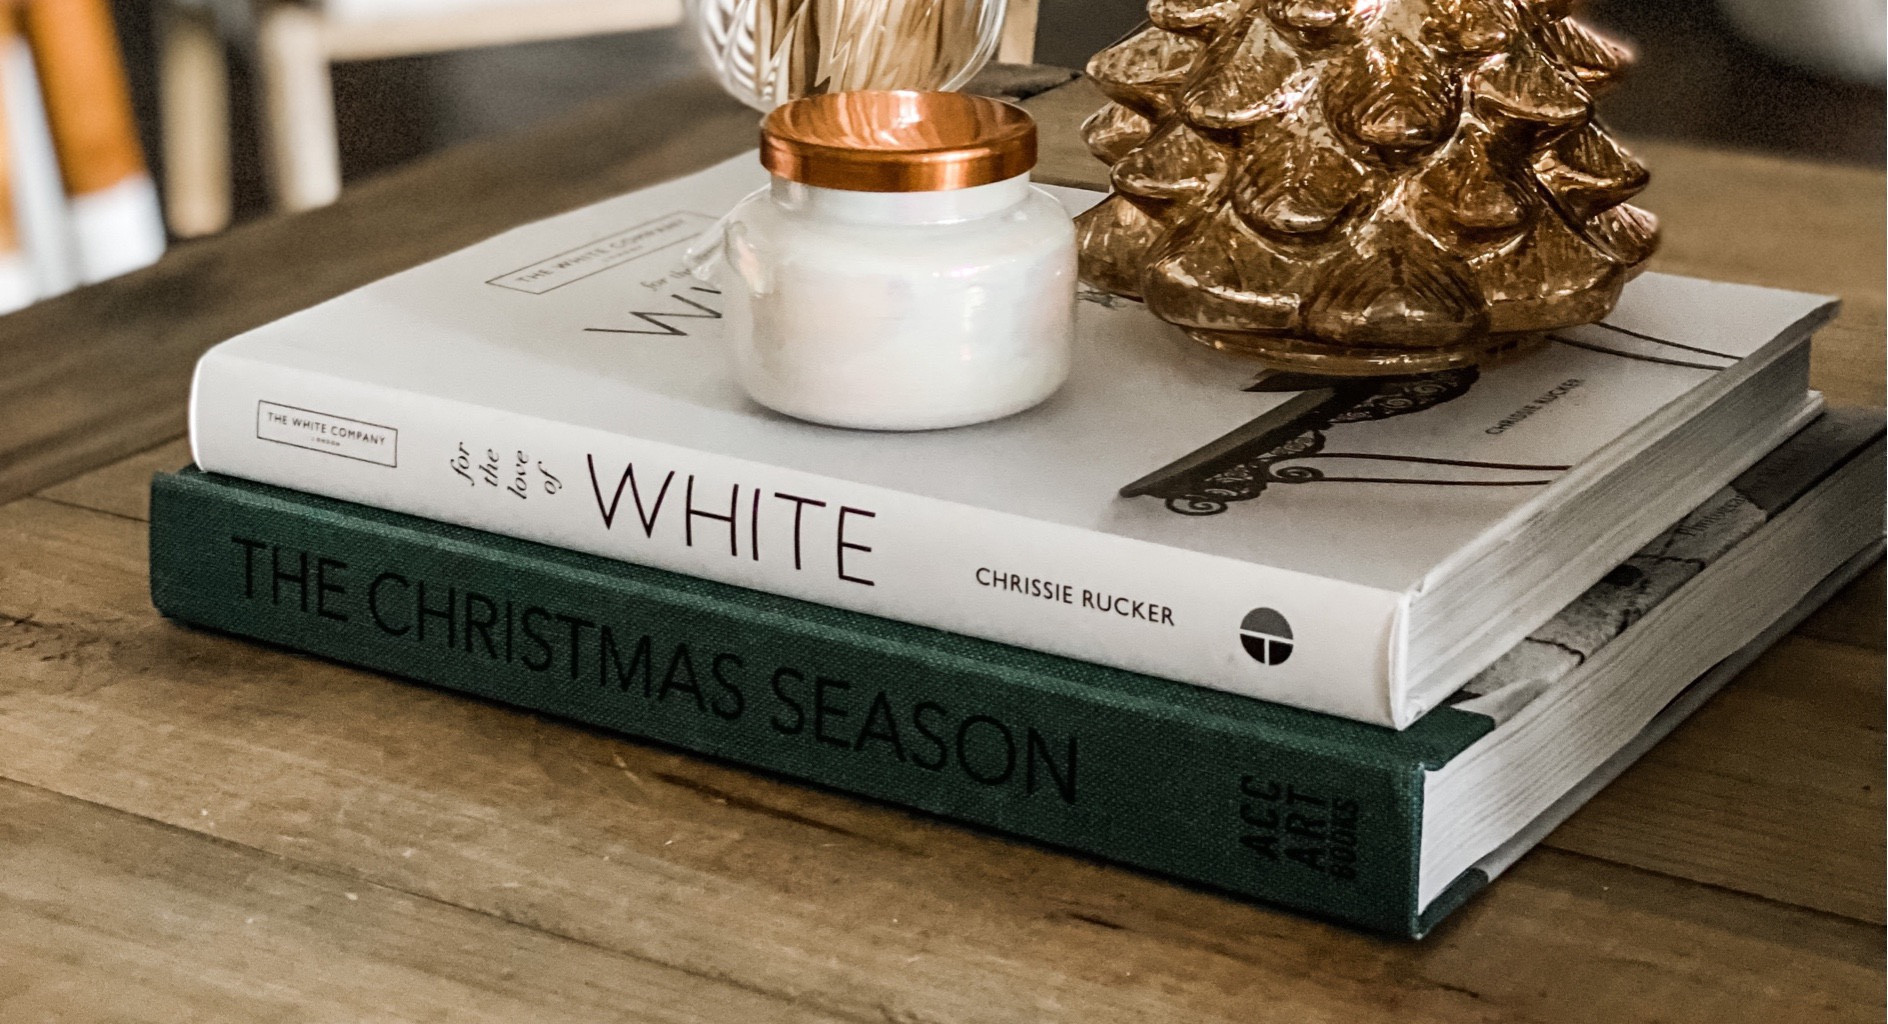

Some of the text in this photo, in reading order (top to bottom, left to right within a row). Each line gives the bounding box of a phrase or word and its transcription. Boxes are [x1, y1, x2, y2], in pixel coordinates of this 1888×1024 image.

[268, 412, 386, 446] THE WHITE COMPANY
[450, 441, 475, 487] for
[478, 448, 500, 487] the
[507, 450, 529, 499] love
[537, 460, 562, 495] of
[587, 453, 876, 587] WHITE
[975, 567, 1175, 627] CHRISSIE RUCKER
[231, 535, 1078, 806] THE CHRISTMAS SEASON
[1239, 775, 1282, 862] ACC
[1284, 783, 1327, 873] ART
[1329, 798, 1360, 879] BOOKS
